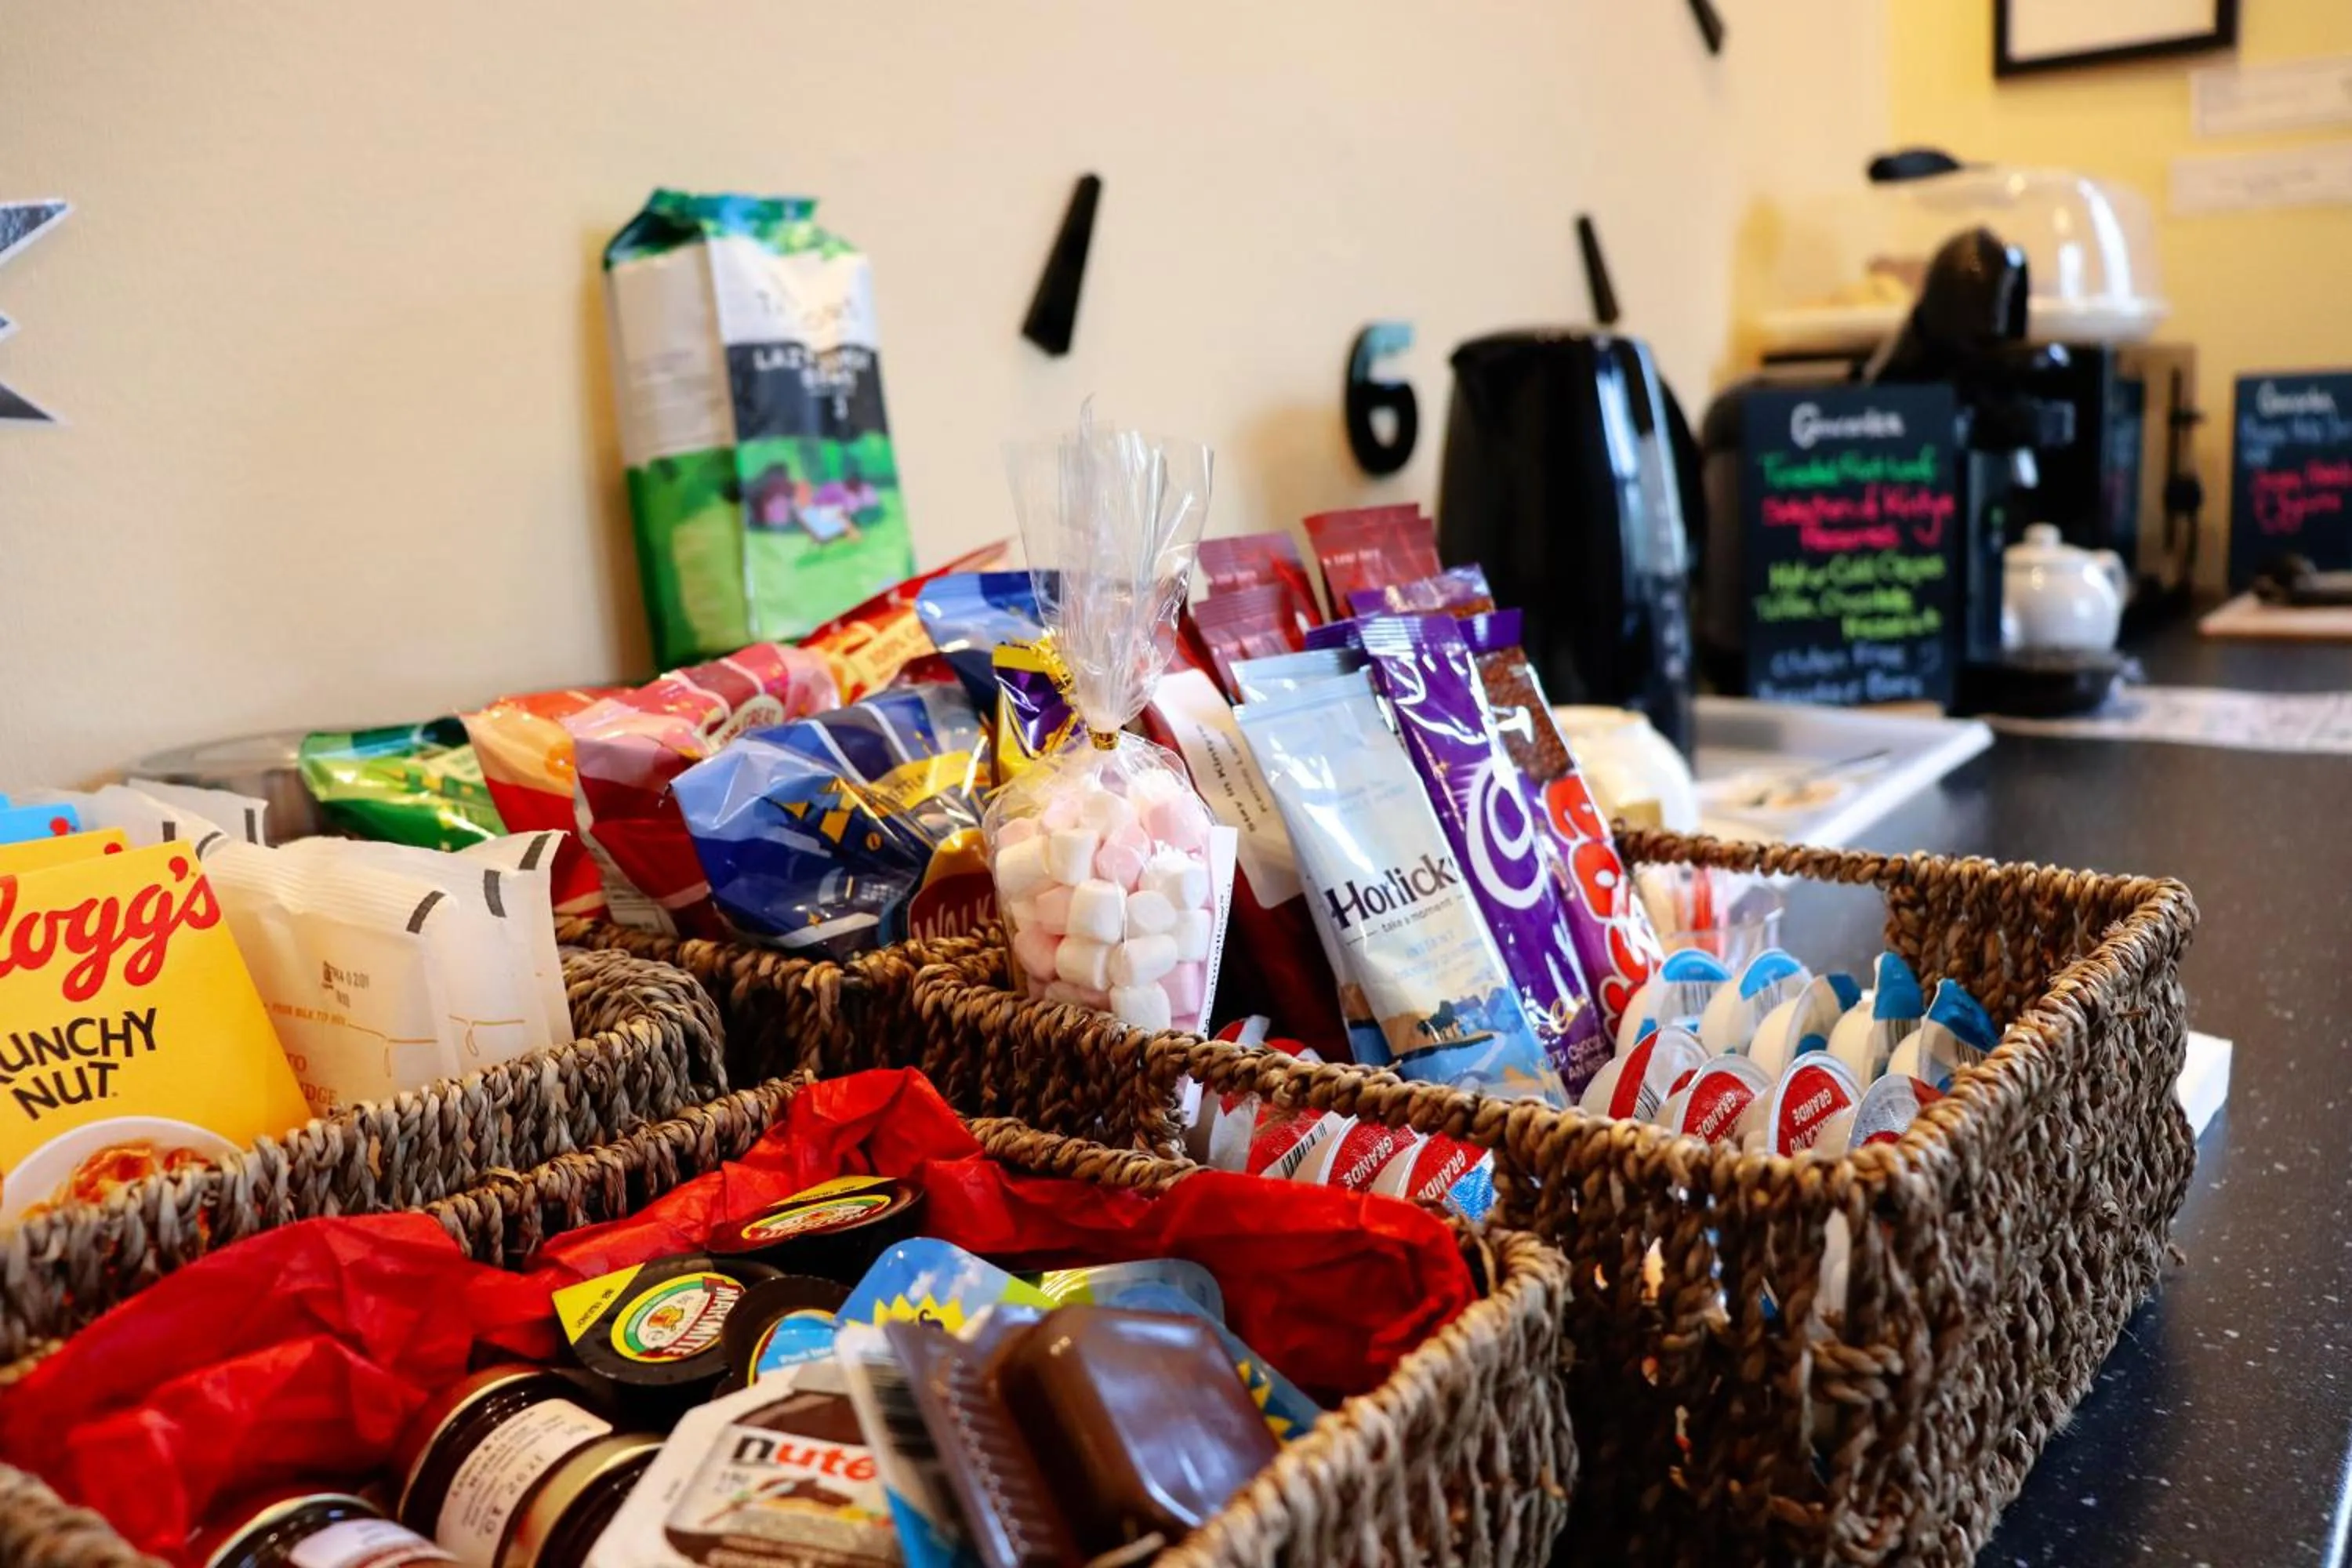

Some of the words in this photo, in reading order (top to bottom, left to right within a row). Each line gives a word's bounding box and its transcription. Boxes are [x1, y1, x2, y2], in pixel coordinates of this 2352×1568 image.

[1343, 321, 1418, 476] 6
[1324, 853, 1458, 931] Horlick
[0, 856, 221, 1002] logg's
[0, 1008, 156, 1083] UNCHY
[11, 1061, 118, 1120] NUT
[1695, 1094, 1739, 1141] GRANDE
[1791, 1088, 1832, 1127] GRANDE
[1345, 1135, 1394, 1189] GRANDE
[731, 1436, 879, 1482] nute
